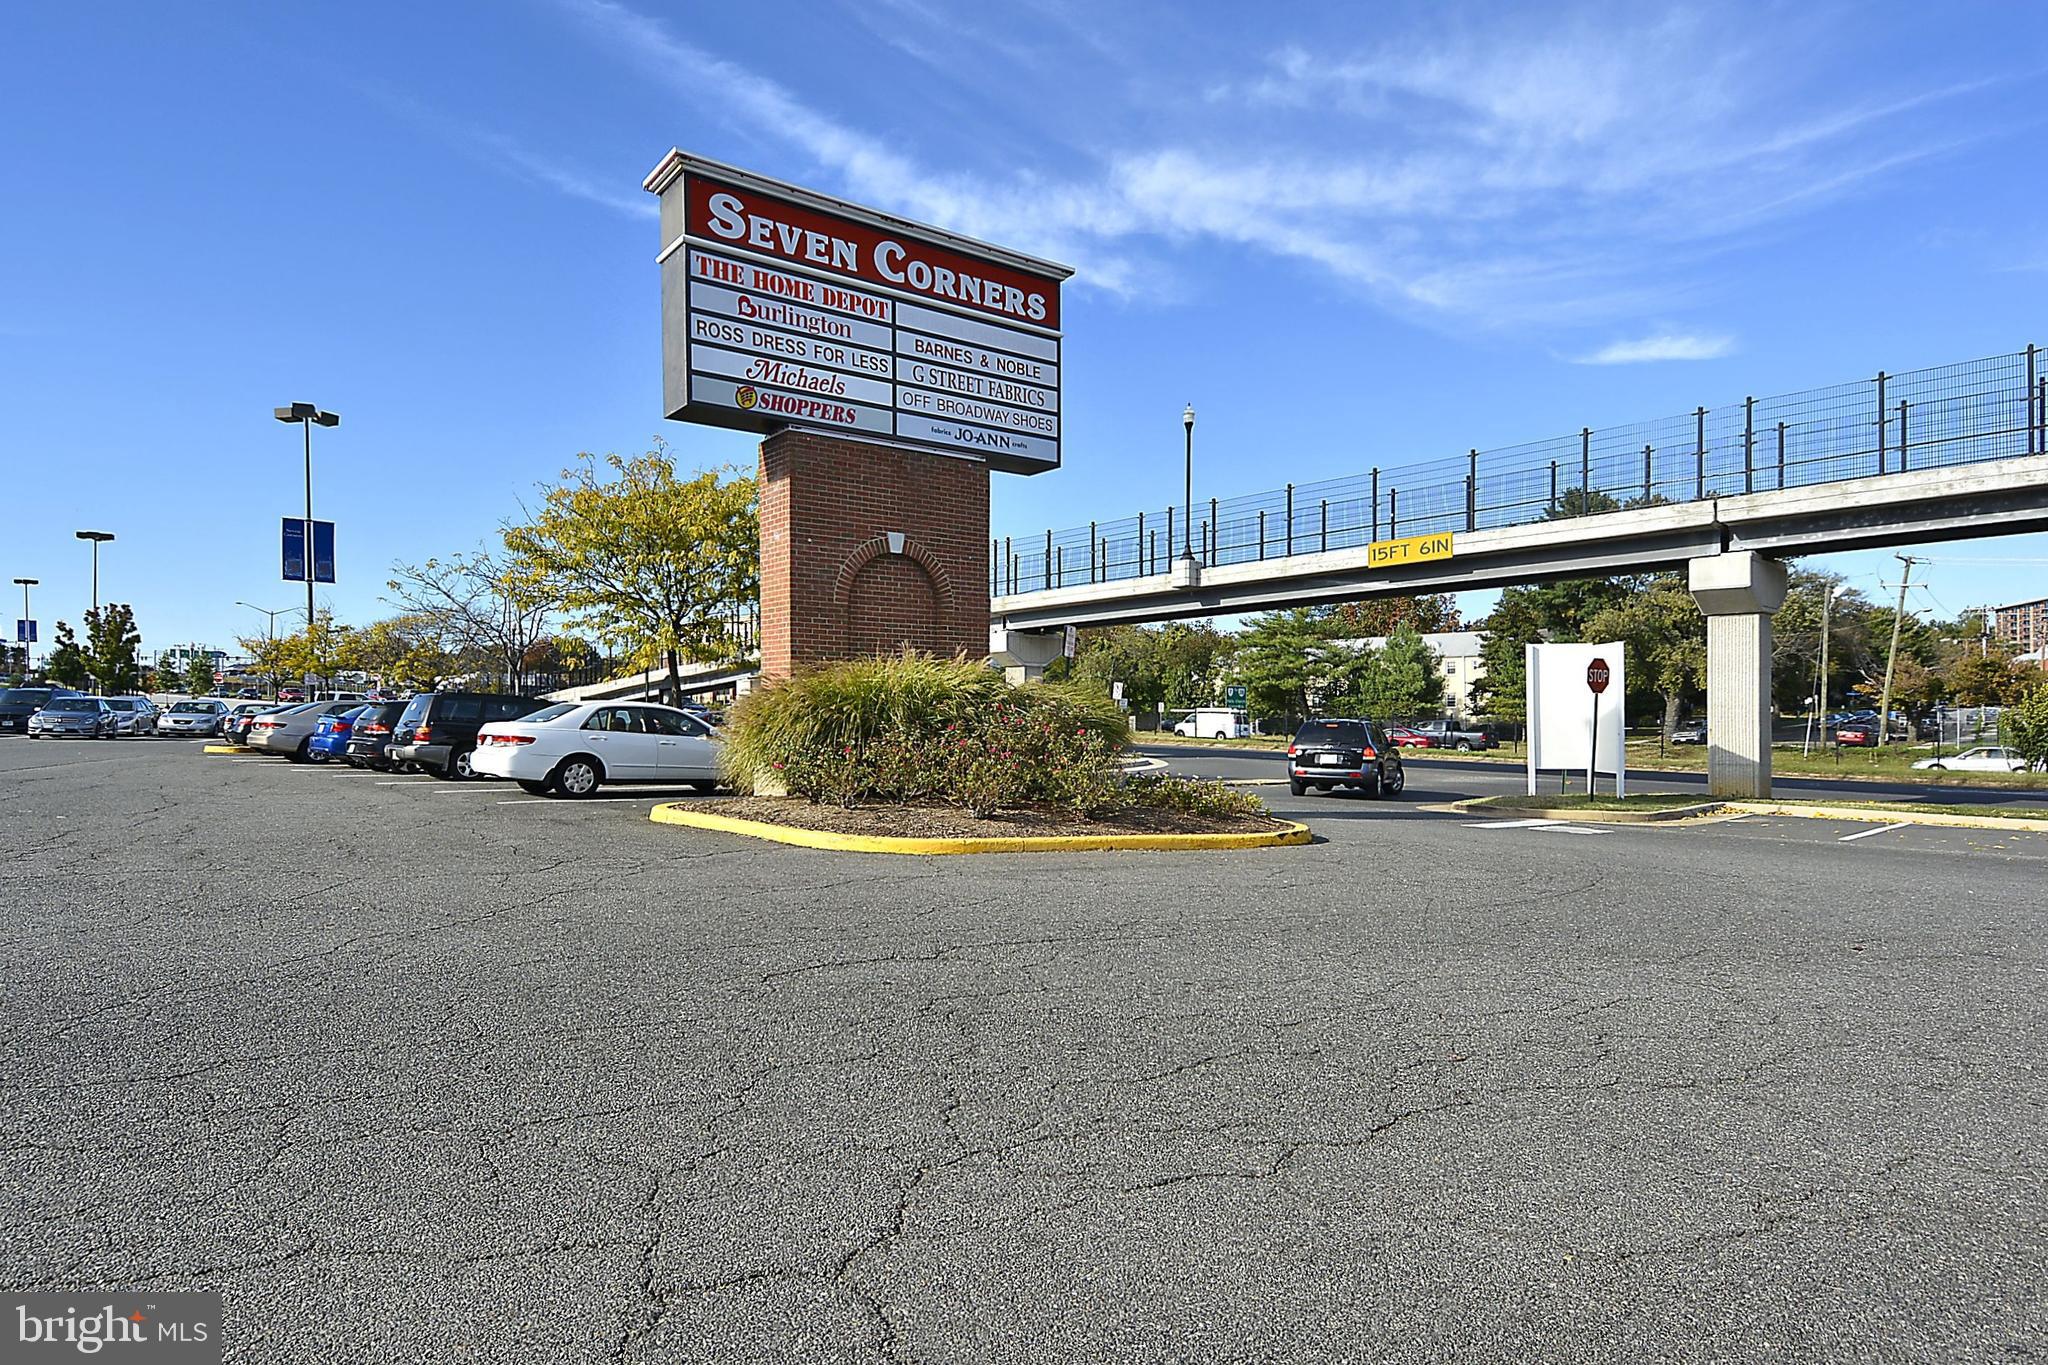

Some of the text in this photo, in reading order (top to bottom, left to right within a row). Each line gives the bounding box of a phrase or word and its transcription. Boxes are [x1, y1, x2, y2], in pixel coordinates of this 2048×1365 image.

[708, 193, 1046, 320] SEVEN CORNERS
[696, 255, 889, 320] THE HOME DEPOT
[737, 294, 852, 339] Burlington
[696, 319, 889, 373] ROSS DRESS FOR LESS
[915, 338, 1041, 379] BARNES & NOBLE
[745, 359, 846, 395] Michaels
[912, 365, 1045, 407] G STREET FABRICS
[758, 392, 856, 425] SHOPPERS
[902, 391, 1053, 432] OFF BROADWAY SHOES
[954, 427, 1010, 449] JO-ANN
[1372, 538, 1449, 561] 15FT 6IN
[1588, 669, 1609, 683] STOP
